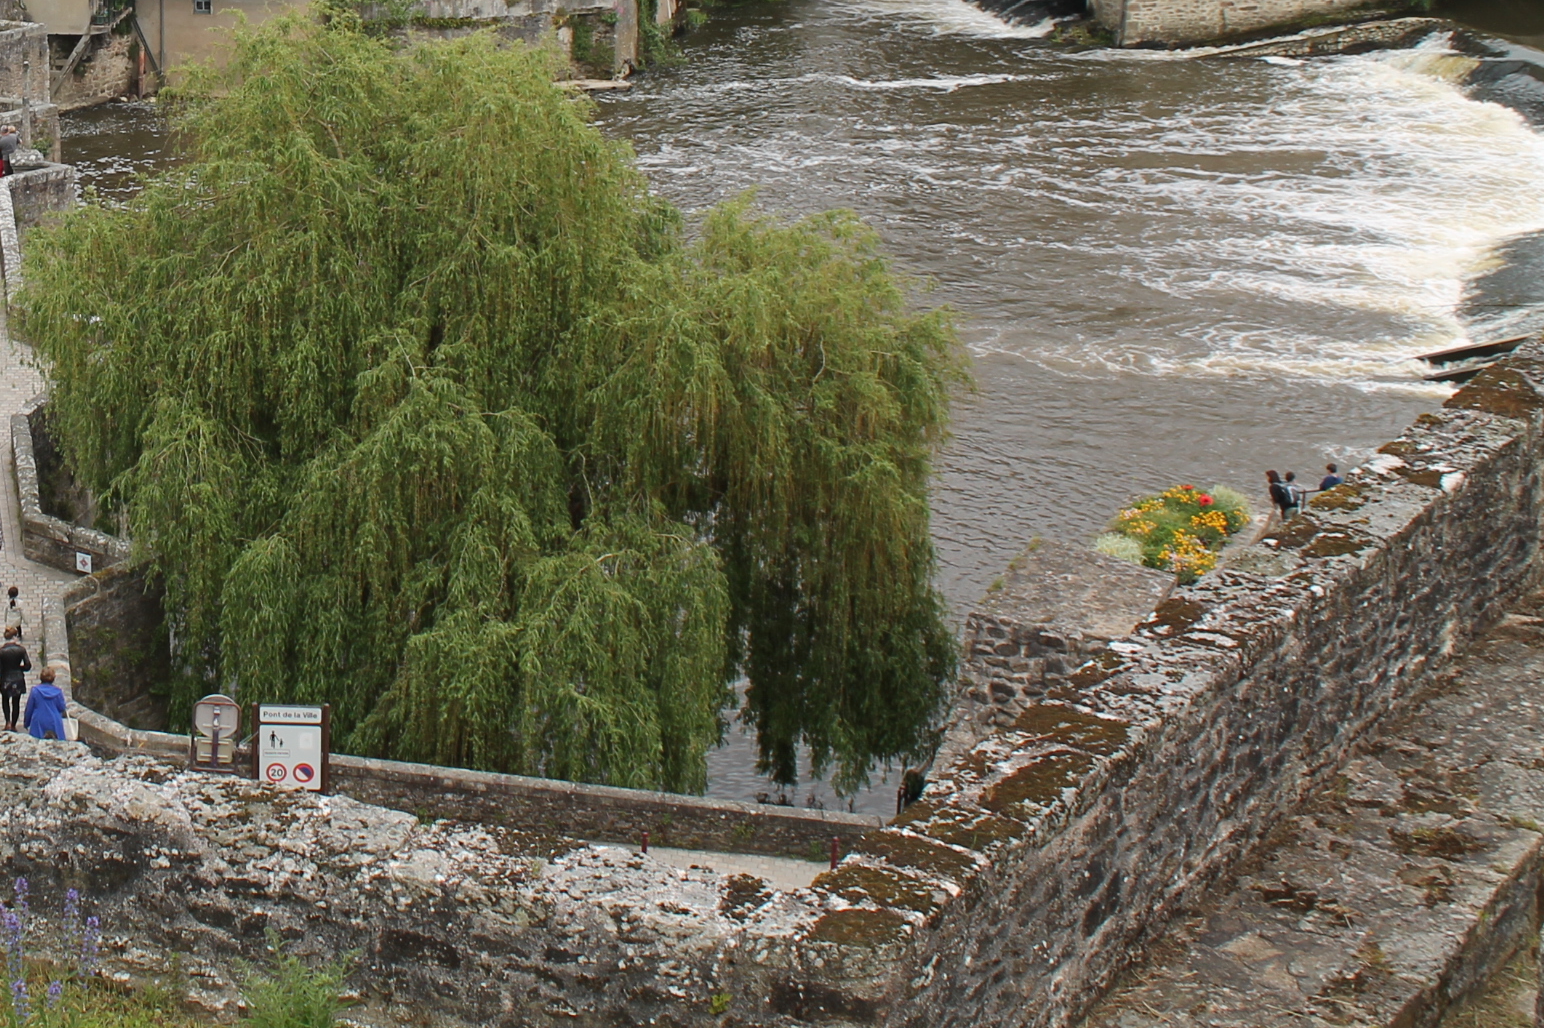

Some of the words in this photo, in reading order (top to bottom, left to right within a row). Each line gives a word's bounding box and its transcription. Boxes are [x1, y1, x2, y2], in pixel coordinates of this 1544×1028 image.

[263, 710, 281, 718] Pont
[282, 711, 293, 719] de
[303, 711, 318, 719] Ville
[271, 768, 283, 777] 20
